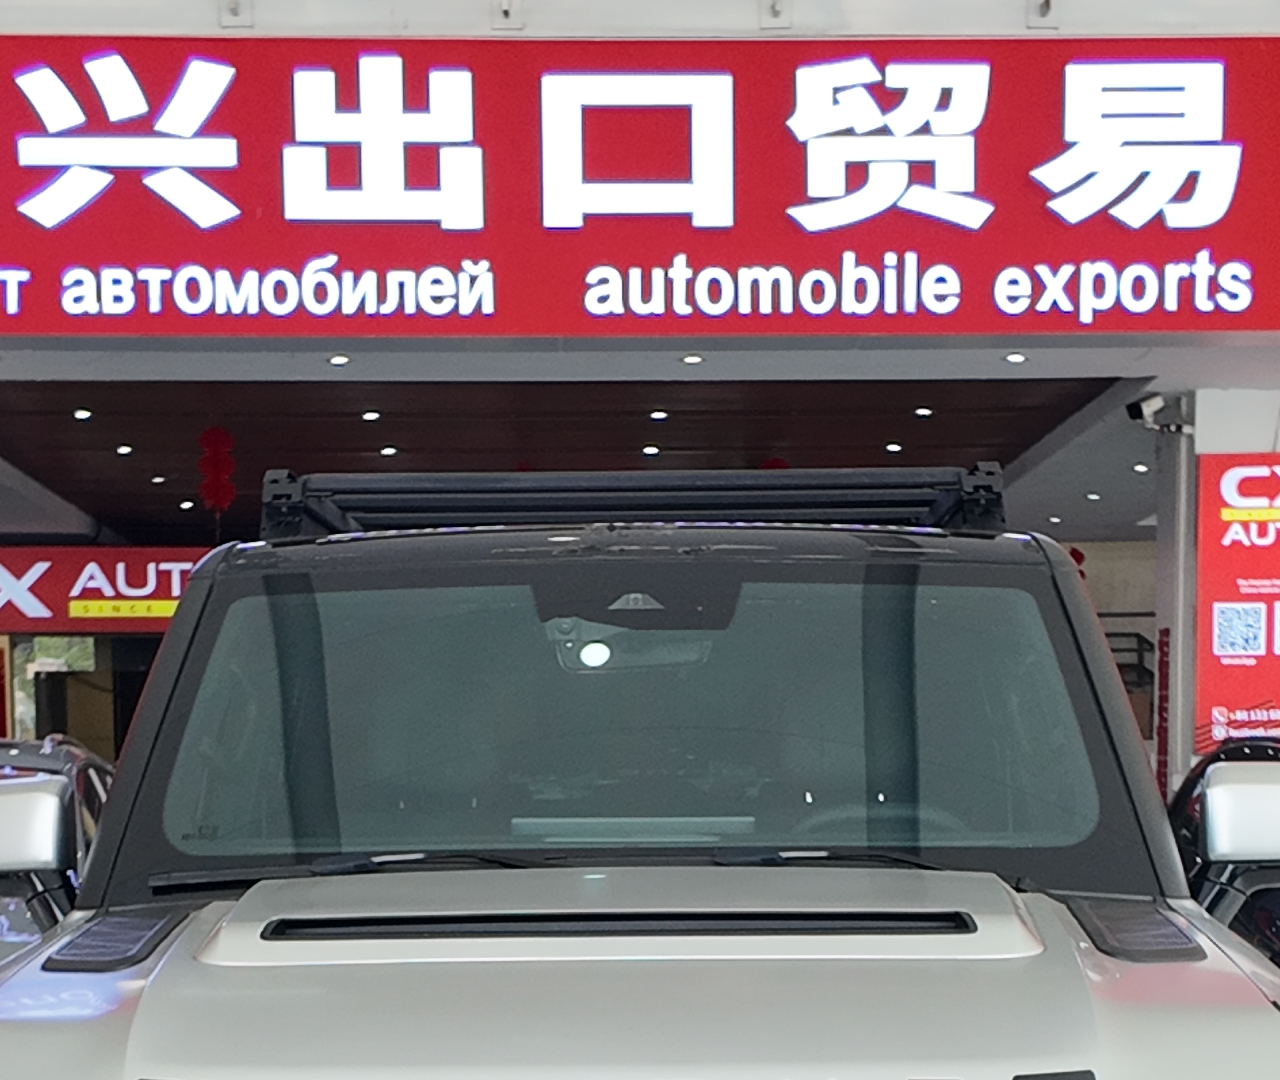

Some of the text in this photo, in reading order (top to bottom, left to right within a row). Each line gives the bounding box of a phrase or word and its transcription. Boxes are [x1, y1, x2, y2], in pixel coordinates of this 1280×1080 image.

[60, 252, 496, 316] автомобилей
[584, 249, 1254, 324] automobile exports
[68, 560, 196, 598] AUT
